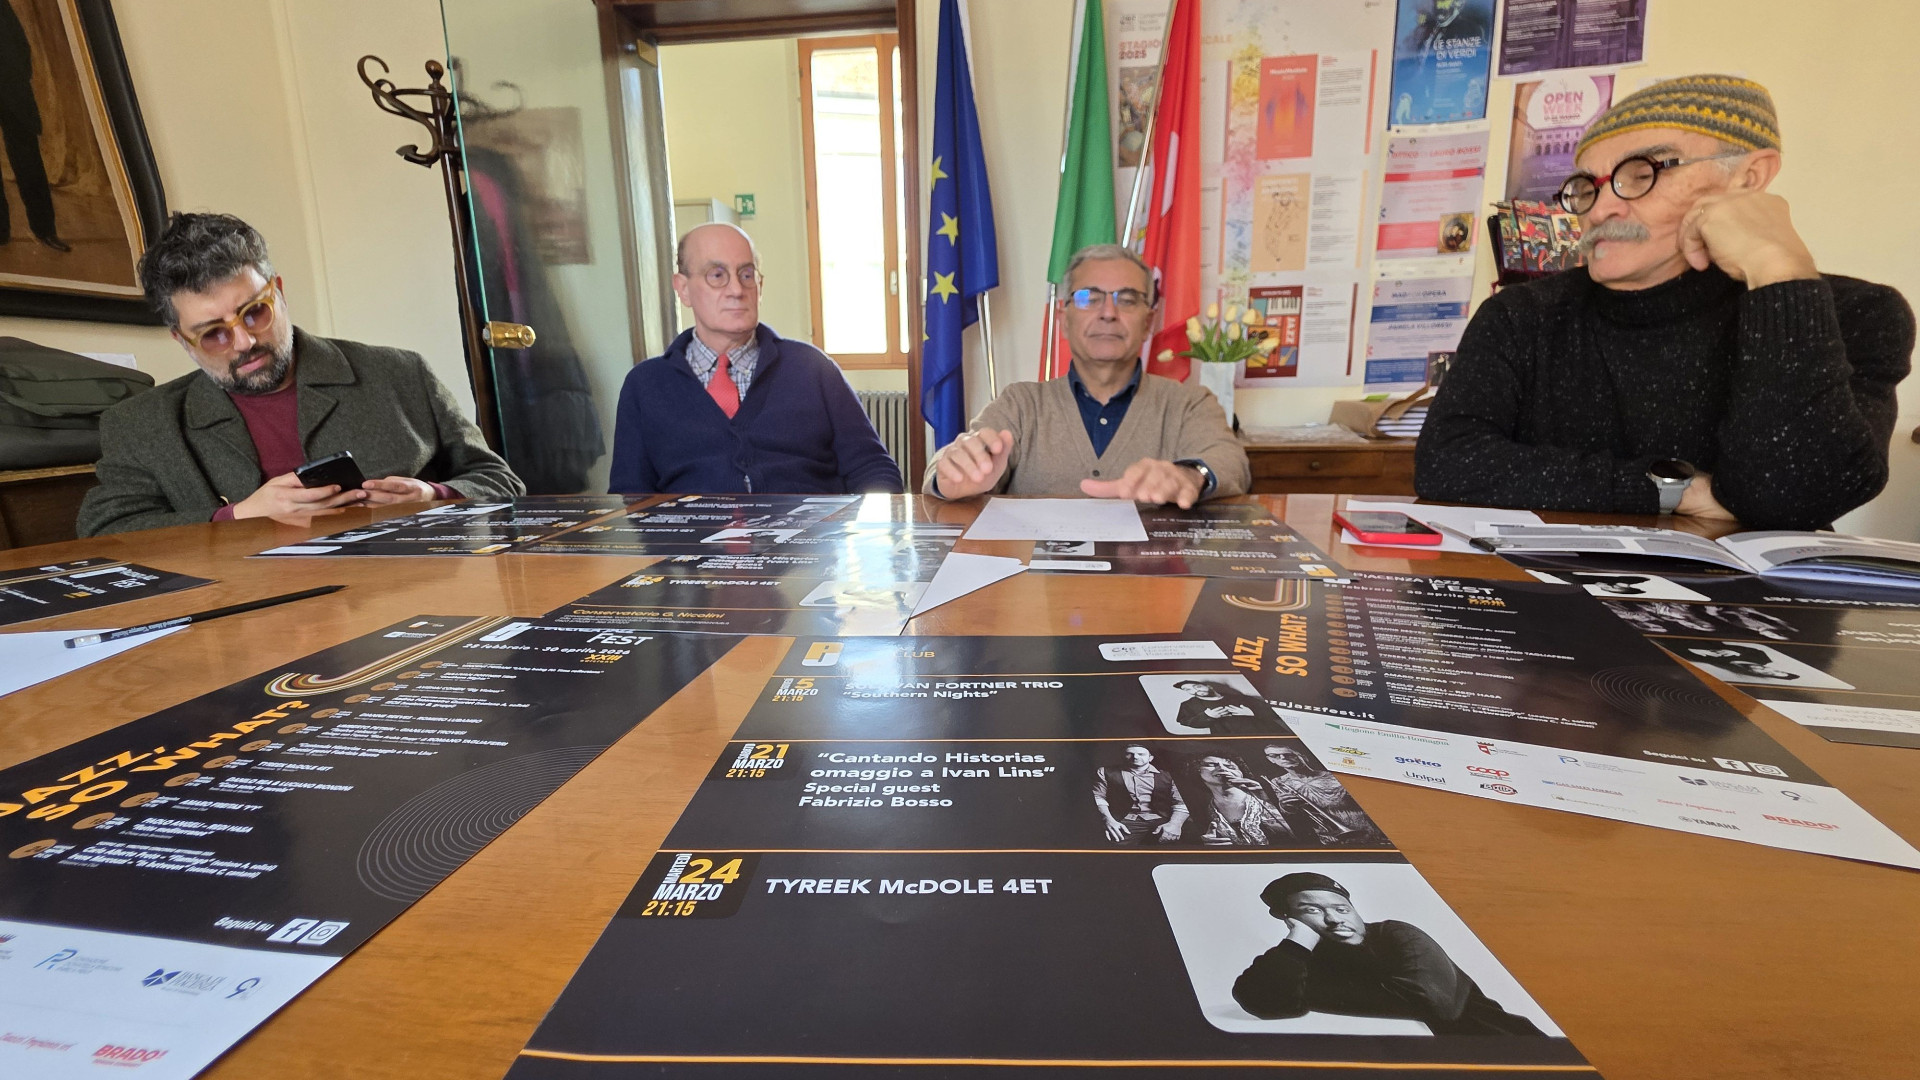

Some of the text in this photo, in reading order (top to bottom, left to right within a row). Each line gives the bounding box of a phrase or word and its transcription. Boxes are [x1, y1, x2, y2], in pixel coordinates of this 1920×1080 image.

[1119, 39, 1162, 51] STAGIO
[1433, 36, 1482, 51] LE STANZE
[1436, 48, 1477, 60] DI VERDI
[1544, 92, 1583, 105] OPEN
[1543, 103, 1582, 114] WEEK
[1353, 572, 1424, 583] PIACENZA
[1342, 584, 1393, 593] febbraio
[1431, 583, 1495, 595] FEST
[573, 609, 659, 617] Conservatorio
[586, 633, 653, 645] FEST
[1275, 613, 1308, 677] SO WHAT?
[584, 653, 624, 661] XXIII
[1231, 636, 1269, 672] JAZZ,
[794, 678, 816, 689] 5
[935, 681, 1018, 689] FORTNER
[1020, 681, 1064, 689] TRIO
[776, 688, 819, 696] MARZO
[933, 690, 998, 699] Nights”
[1341, 725, 1450, 746] Regione Emilia-Romagna
[750, 744, 790, 760] 21
[817, 752, 1046, 763] “Cantando Historias
[1642, 749, 1689, 761] Seguici
[26, 700, 310, 821] SO WHAT?
[732, 759, 785, 769] MARZO
[725, 769, 766, 778] 21:15
[810, 766, 1056, 781] omaggio a Ivan Lins”
[1466, 765, 1510, 777] coop
[0, 746, 165, 817] JAZZ,
[1403, 771, 1446, 784] Unipol
[803, 782, 941, 795] Special guest
[178, 799, 246, 810] AMARO FREITAS
[797, 796, 953, 807] Fabrizio Bosso
[141, 817, 175, 825] PAOLO
[227, 825, 254, 834] HASA
[1693, 818, 1741, 831] YAMAHA
[1762, 814, 1839, 830] BRADO!
[82, 846, 108, 854] Carlo
[104, 848, 139, 857] Alberto
[662, 853, 693, 884] MARTEDÌ
[678, 858, 743, 884] 24
[652, 884, 724, 900] MARZO
[766, 878, 1053, 895] TYREEK McDOLE 4ET
[642, 901, 698, 916] 21:15
[213, 916, 273, 933] Seguici su
[92, 1043, 169, 1062] BRADO!
